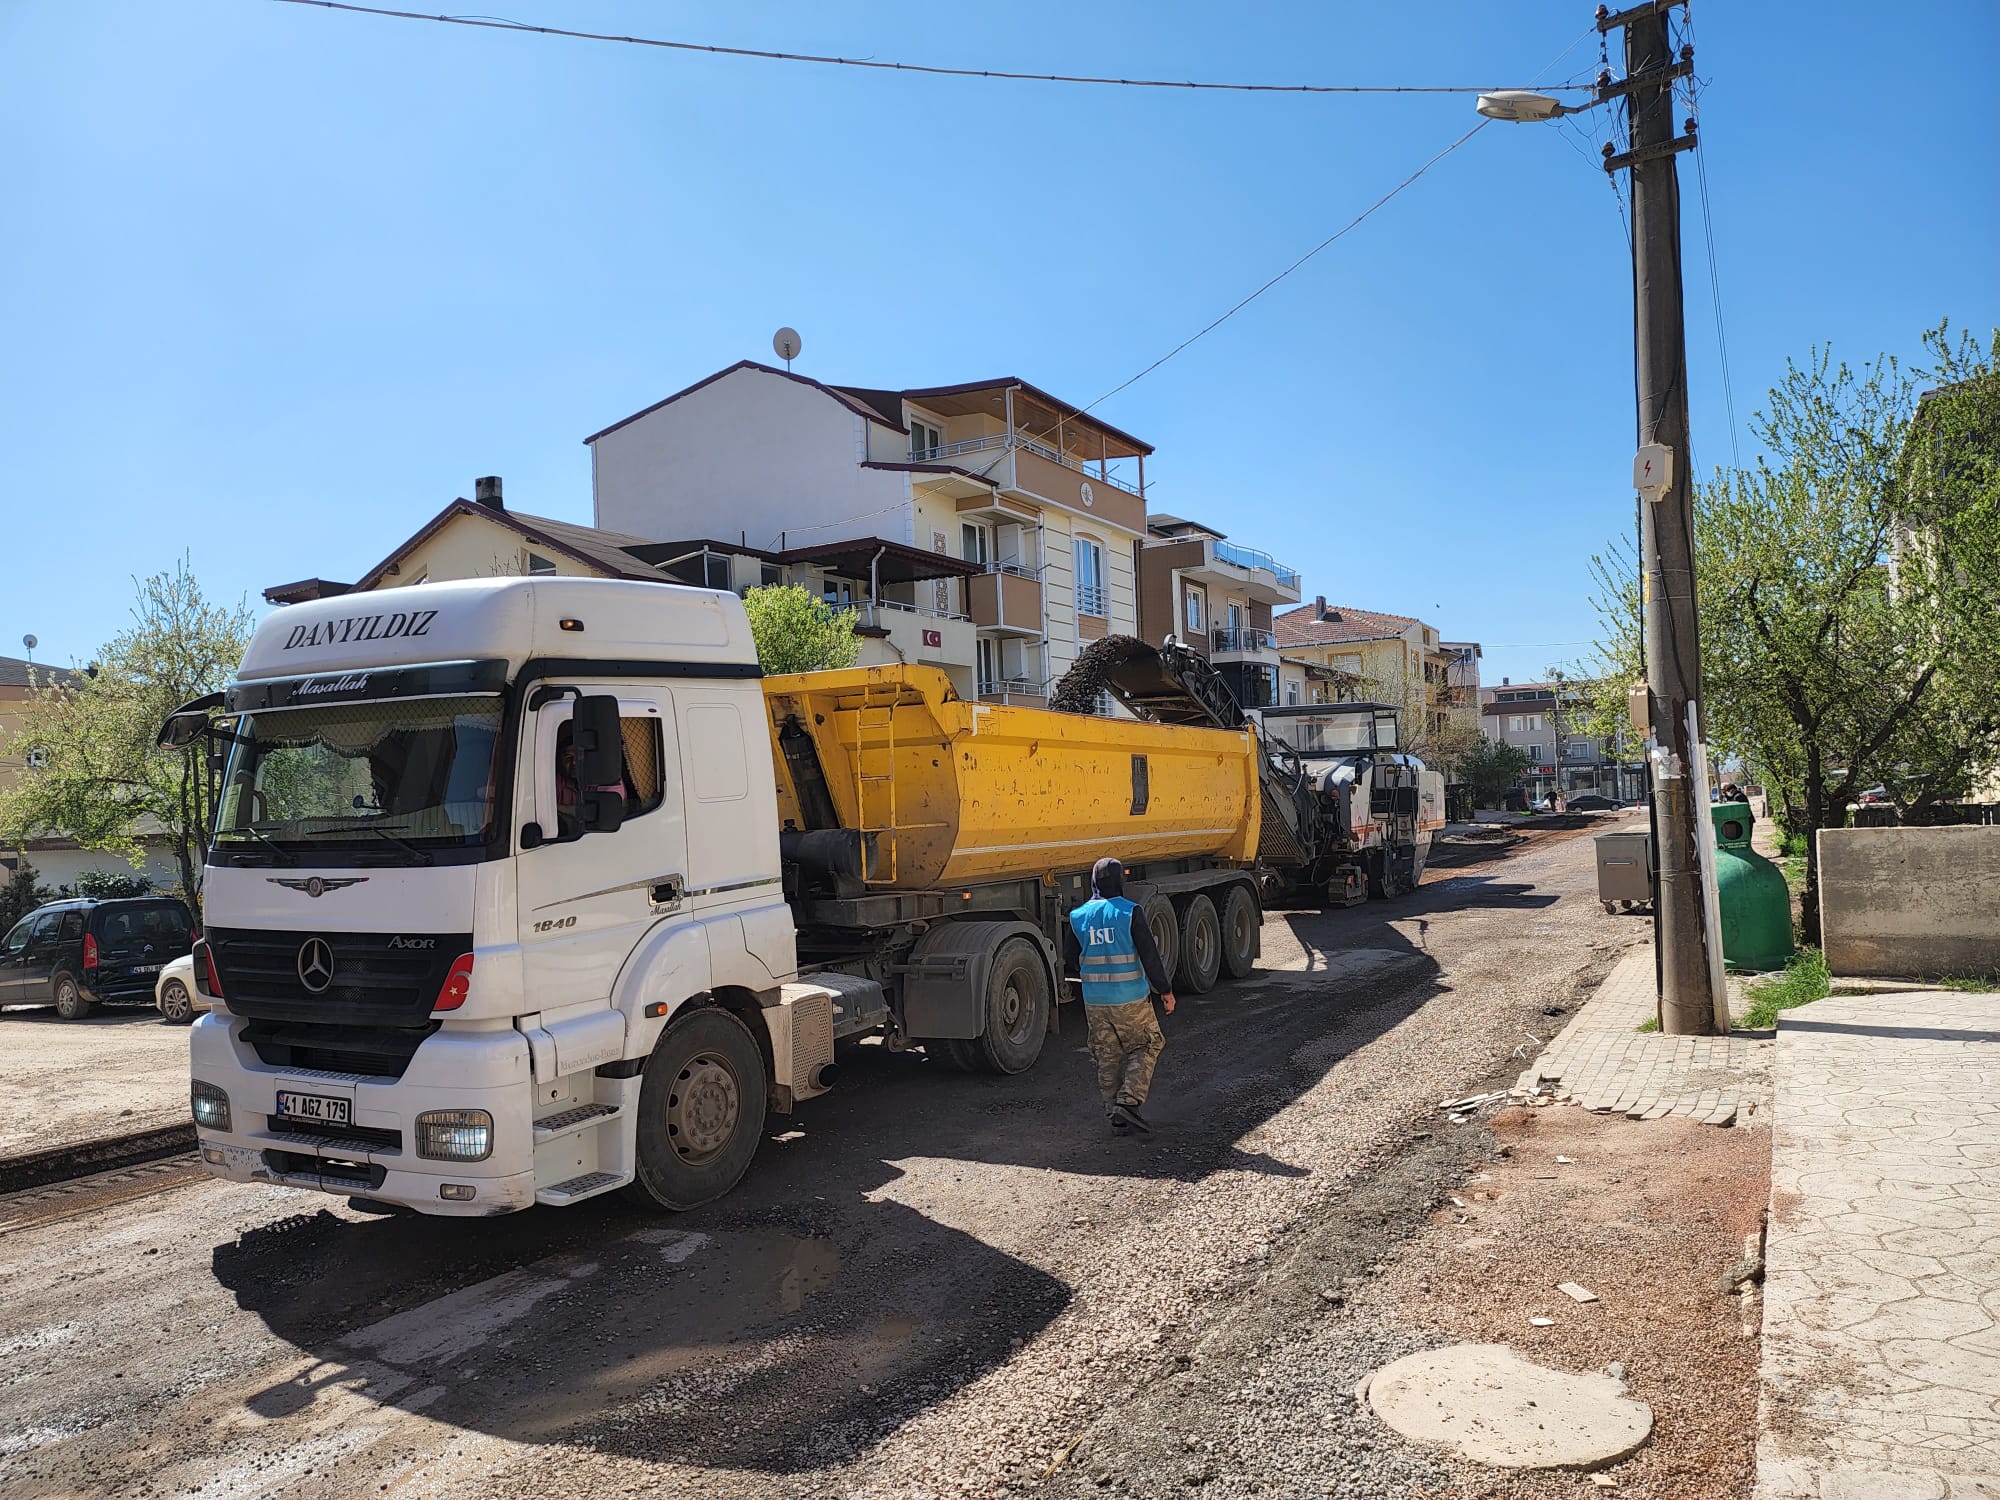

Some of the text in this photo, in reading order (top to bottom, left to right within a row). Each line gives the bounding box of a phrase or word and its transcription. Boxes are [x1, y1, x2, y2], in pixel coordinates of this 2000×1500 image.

[283, 610, 439, 650] DANYILDIZ
[532, 915, 577, 933] 1840
[1088, 925, 1115, 946] İSU
[284, 1096, 347, 1120] 41 AGZ 179
